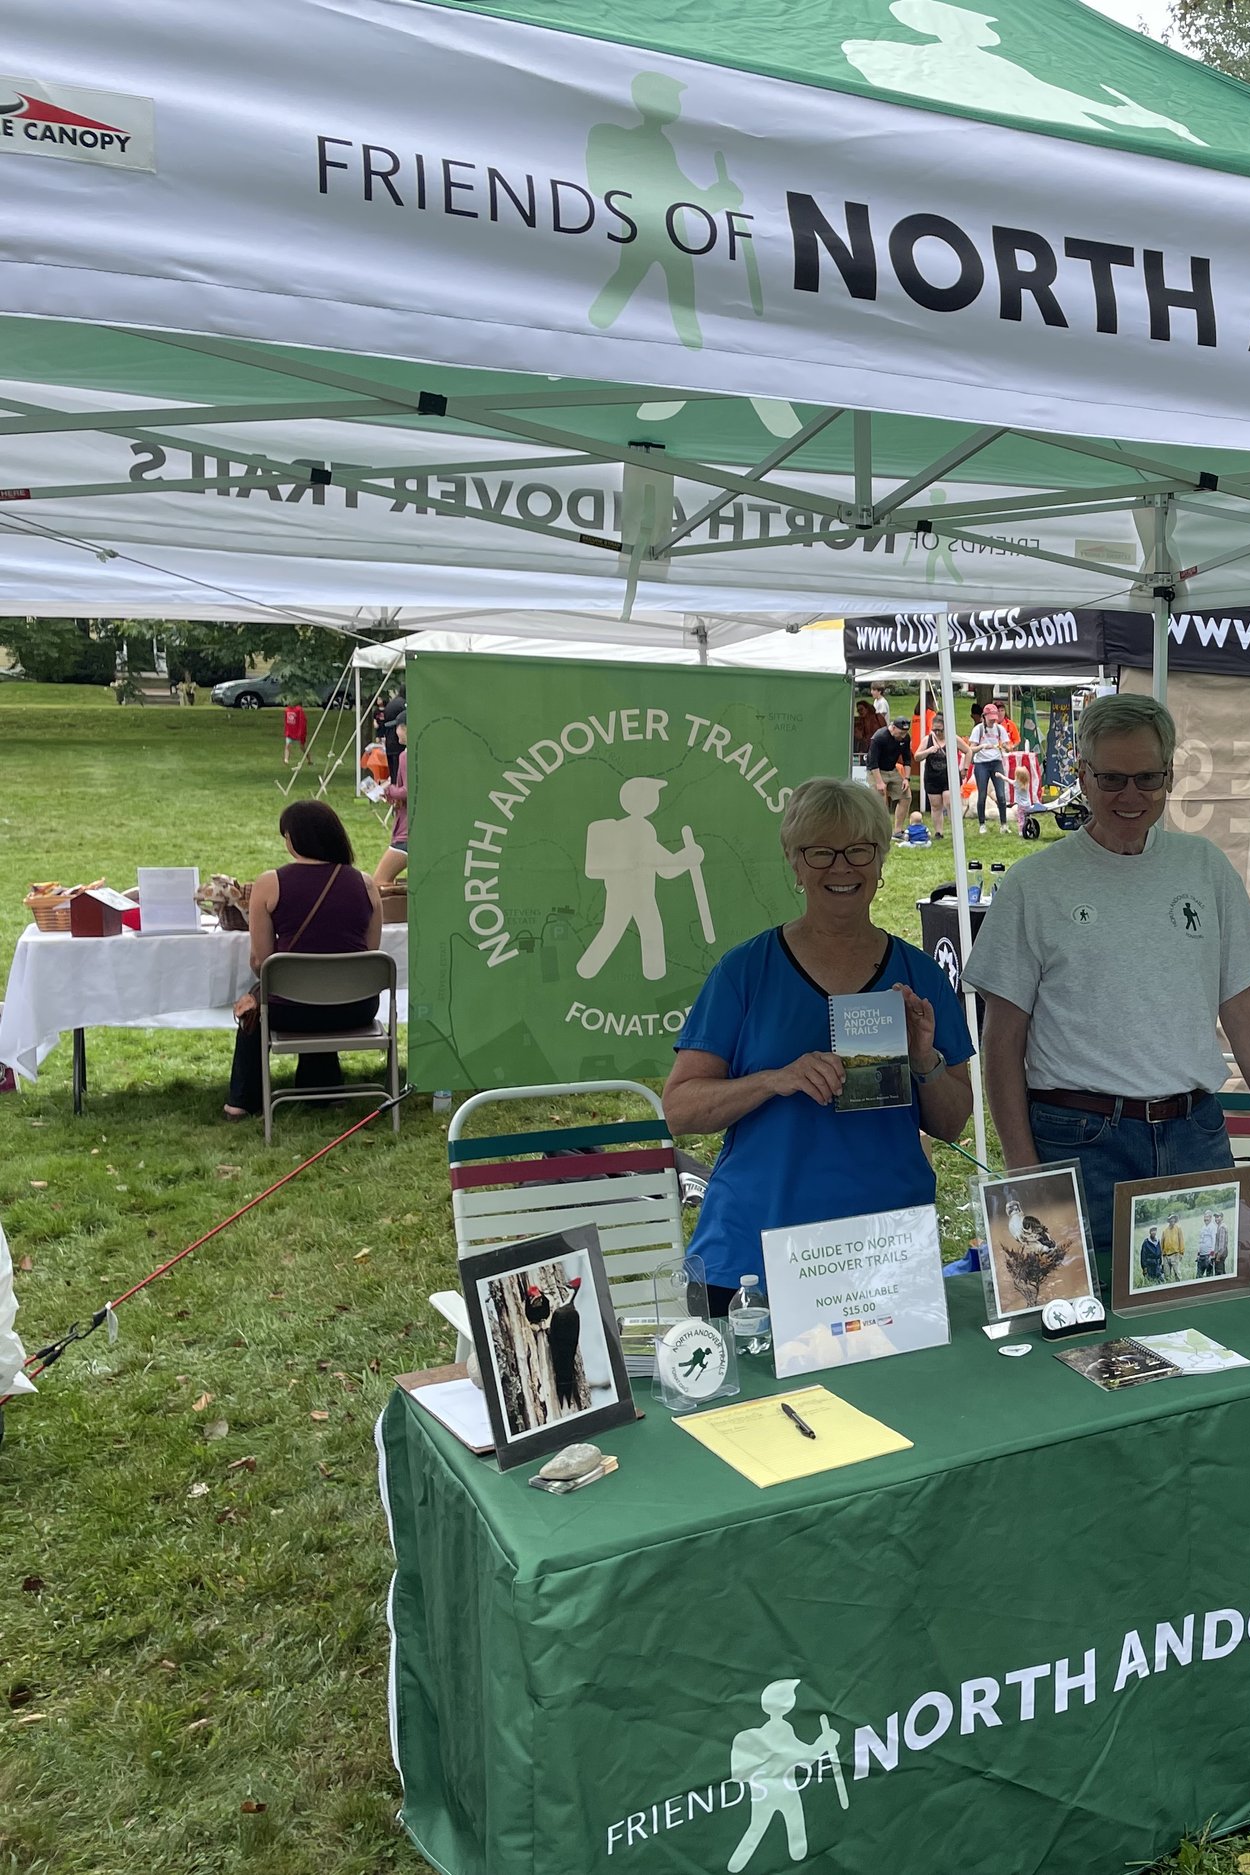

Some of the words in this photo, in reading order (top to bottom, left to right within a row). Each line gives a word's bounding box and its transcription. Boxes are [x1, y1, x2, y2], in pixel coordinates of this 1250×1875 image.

[24, 122, 132, 152] CANOPY
[316, 134, 640, 245] FRIENDS
[665, 201, 756, 262] OF
[785, 191, 1218, 348] NORTH
[856, 607, 1078, 653] www.CLUBILATES.com
[488, 708, 669, 821] ANDOVER
[685, 714, 793, 813] TRAILS
[464, 819, 519, 968] NORTH
[843, 1008, 880, 1020] NORTH
[844, 1016, 893, 1029] ANDOVER
[844, 1026, 879, 1037] TRAILS
[789, 1252, 799, 1263] A
[801, 1244, 842, 1262] GUIDE
[845, 1241, 864, 1254] TO
[867, 1233, 913, 1251] NORTH
[798, 1258, 863, 1279] ANDOVER
[865, 1250, 908, 1268] TRAILS
[816, 1294, 843, 1308] NOW
[845, 1284, 900, 1302] AVAILABLE
[842, 1302, 876, 1317] $15.00
[862, 1319, 877, 1327] VISA
[672, 1331, 695, 1353] NORTH
[693, 1329, 722, 1349] ANDOVER
[606, 1770, 769, 1856] FRIENDS
[783, 1753, 836, 1791] OF
[853, 1647, 1097, 1781] NORTH
